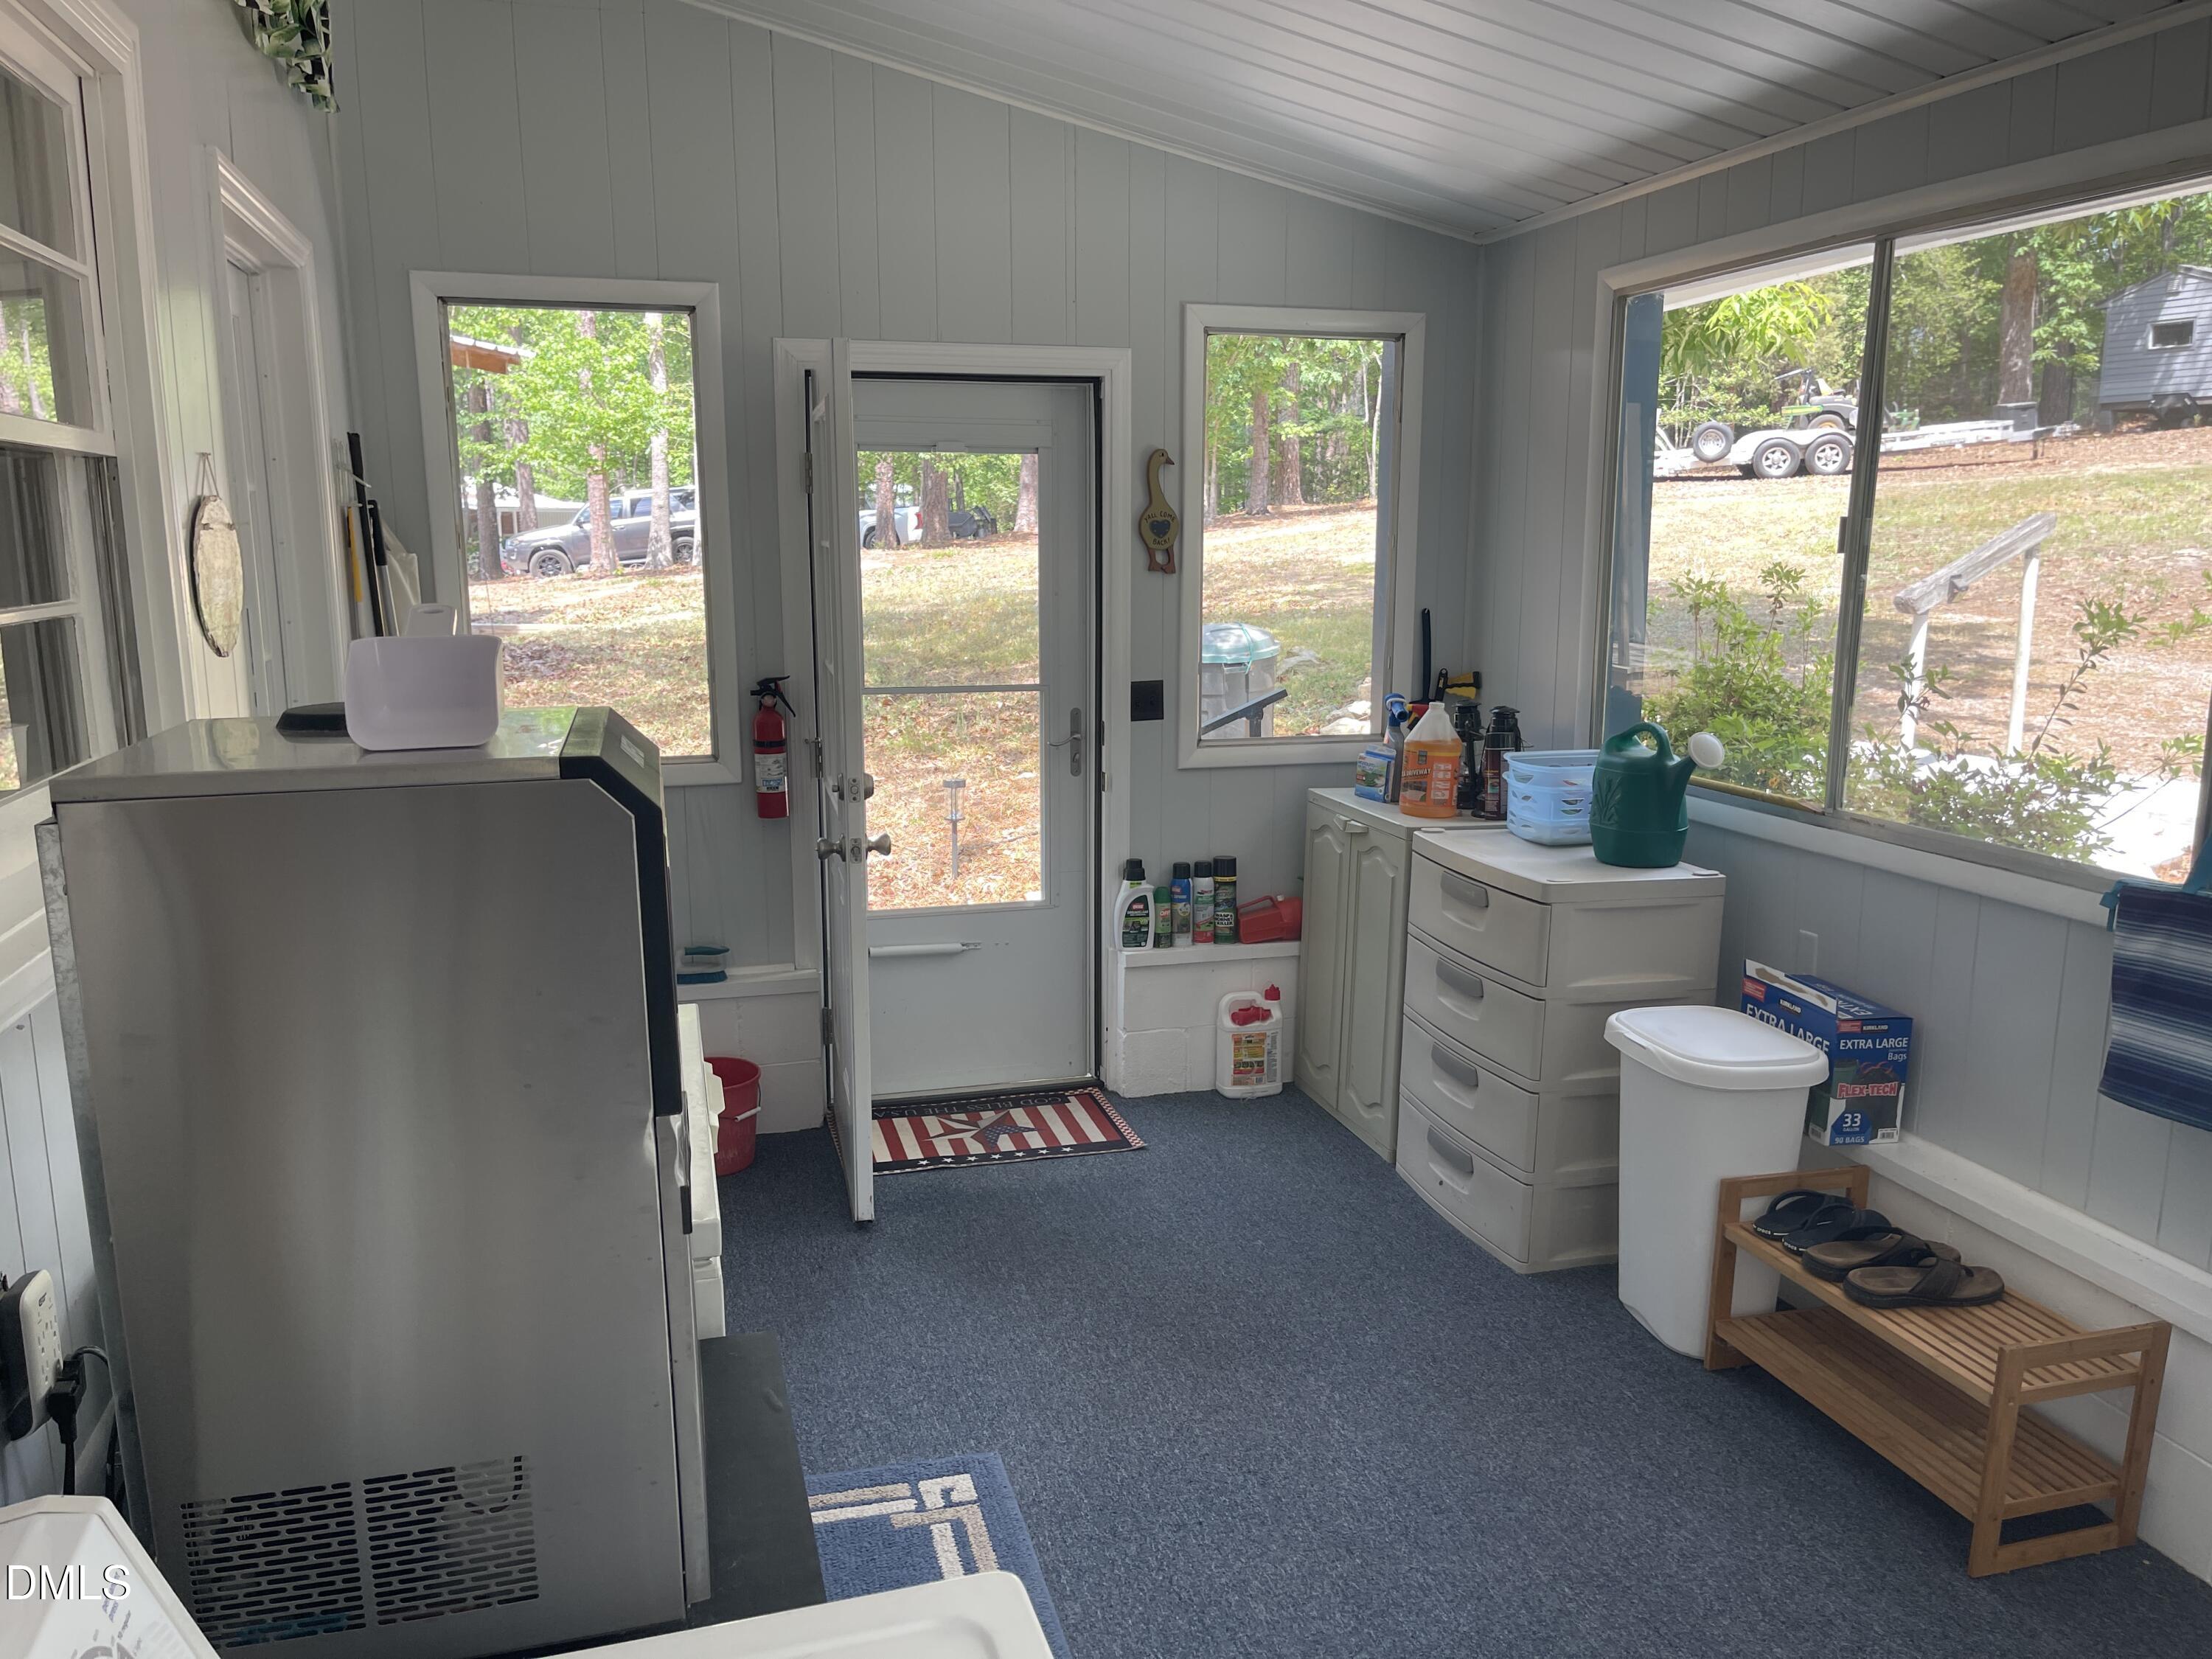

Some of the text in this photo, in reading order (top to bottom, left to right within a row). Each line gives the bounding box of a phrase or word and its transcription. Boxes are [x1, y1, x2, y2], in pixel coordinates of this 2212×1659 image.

[1160, 510, 1176, 523] COME
[1152, 538, 1170, 546] BACK!
[1406, 768, 1431, 777] DRIVEWAY
[1746, 1003, 1786, 1032] EXTRA
[1840, 1037, 1909, 1050] EXTRA LARGE
[1888, 1052, 1907, 1062] Bags
[1837, 1082, 1899, 1098] FLEX-TECH
[1020, 1096, 1061, 1105] GOD
[923, 1105, 961, 1115] THE
[967, 1101, 1013, 1112] BLESS
[1843, 1113, 1862, 1127] 33
